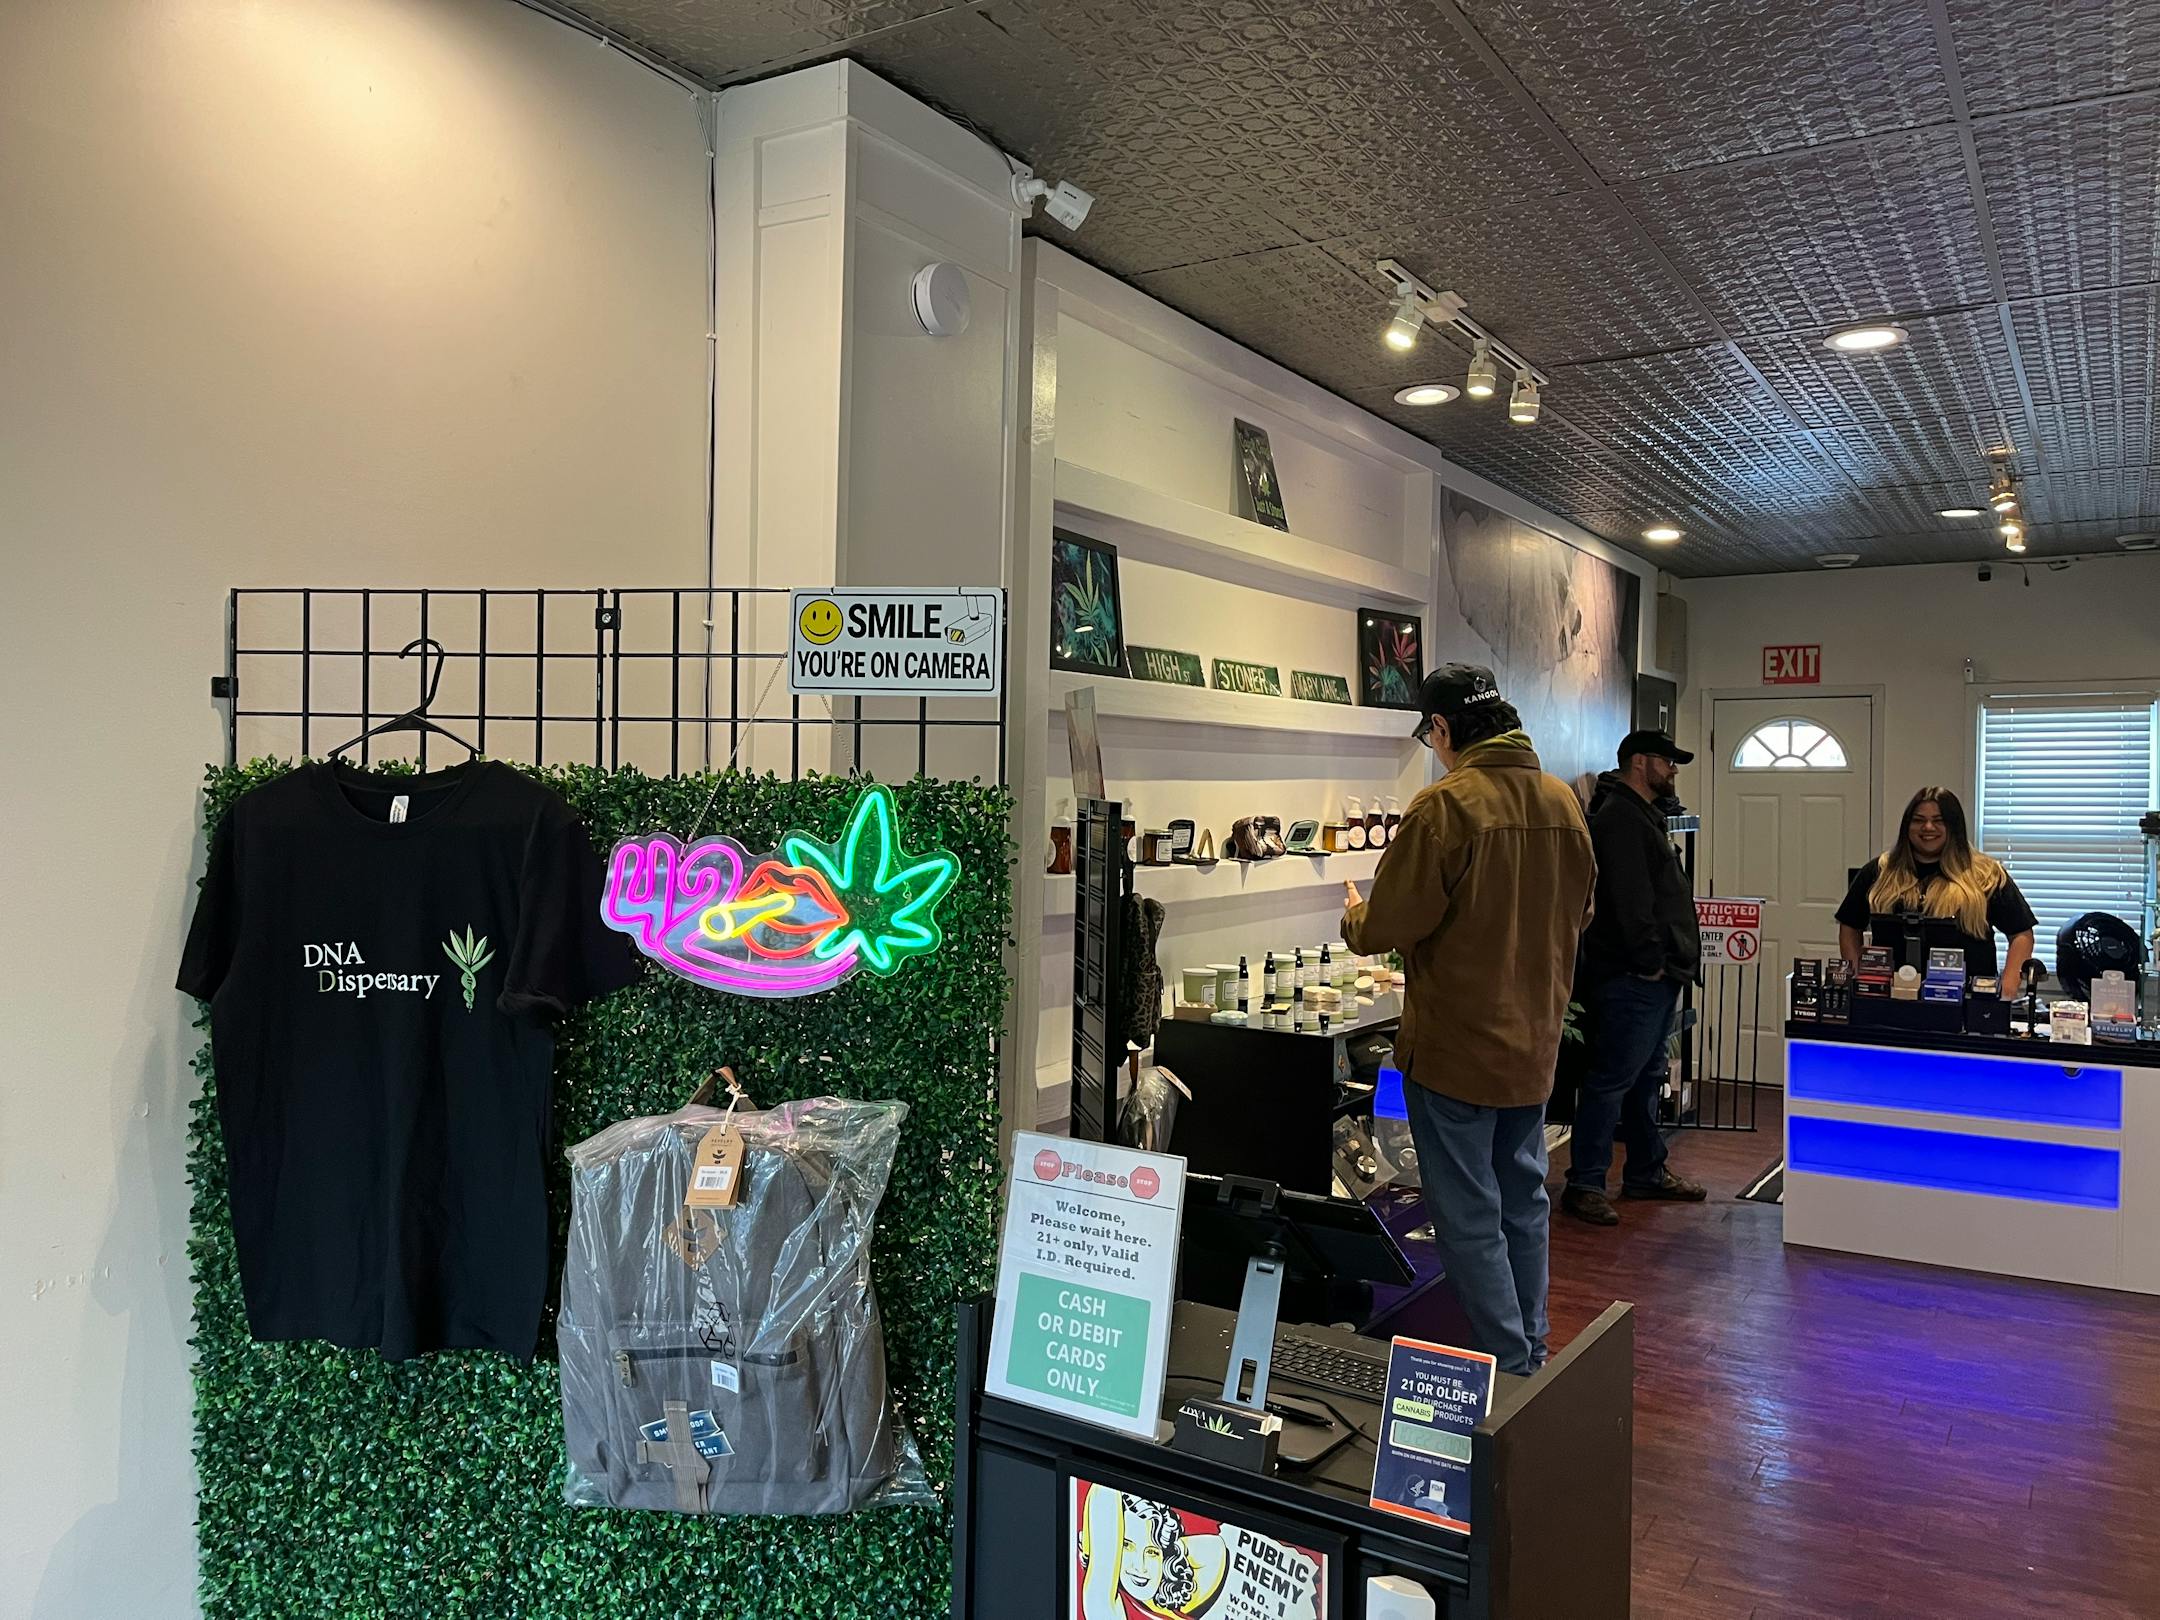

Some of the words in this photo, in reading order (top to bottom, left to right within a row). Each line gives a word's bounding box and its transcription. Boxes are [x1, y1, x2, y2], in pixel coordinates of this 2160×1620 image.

[848, 603, 942, 639] SMILE
[797, 651, 866, 678] YOU'RE
[871, 652, 899, 679] ON
[904, 653, 990, 679] CAMERA
[1145, 651, 1181, 681] HIGH
[1183, 670, 1190, 682] ST
[1765, 648, 1818, 678] EXIT
[1219, 662, 1269, 694] STONER
[1295, 673, 1320, 700] MARY
[1320, 677, 1338, 701] JANE
[1699, 914, 1734, 925] AREA
[1702, 931, 1723, 941] ENTER
[303, 941, 365, 967] DNA
[1040, 1161, 1056, 1169] STOP
[1061, 1161, 1129, 1189] Please
[1136, 1178, 1153, 1186] STOP
[1055, 1200, 1126, 1227] Welcome,
[1030, 1212, 1077, 1232] Please
[1080, 1225, 1111, 1238] wait
[1114, 1228, 1152, 1248] here.
[1036, 1231, 1060, 1245] 21+
[1063, 1238, 1099, 1257] only,
[1102, 1244, 1140, 1264] Valid
[1036, 1248, 1061, 1264] I.D.
[1065, 1254, 1136, 1281] Required.
[1058, 1290, 1107, 1318] CASH
[1038, 1312, 1064, 1335] OR
[1069, 1319, 1123, 1349] DEBIT
[1046, 1341, 1107, 1372] CARDS
[1047, 1368, 1100, 1397] ONLY
[1400, 1378, 1414, 1391] 21
[1416, 1381, 1434, 1396] OR
[1436, 1385, 1478, 1406] OLDER
[1414, 1370, 1430, 1381] YOU
[1430, 1374, 1452, 1386] MUST
[1452, 1378, 1463, 1388] BE
[1395, 1402, 1432, 1418] CANNABIS
[1434, 1409, 1474, 1426] PRODUCTS
[1412, 1395, 1422, 1404] TO
[1423, 1397, 1463, 1414] PURCHASE
[1432, 1484, 1444, 1492] FDA
[1237, 1529, 1309, 1584] PUBLIC
[1233, 1552, 1304, 1605] ENEMY
[1226, 1604, 1241, 1617] CRY
[1277, 1602, 1286, 1618] 1
